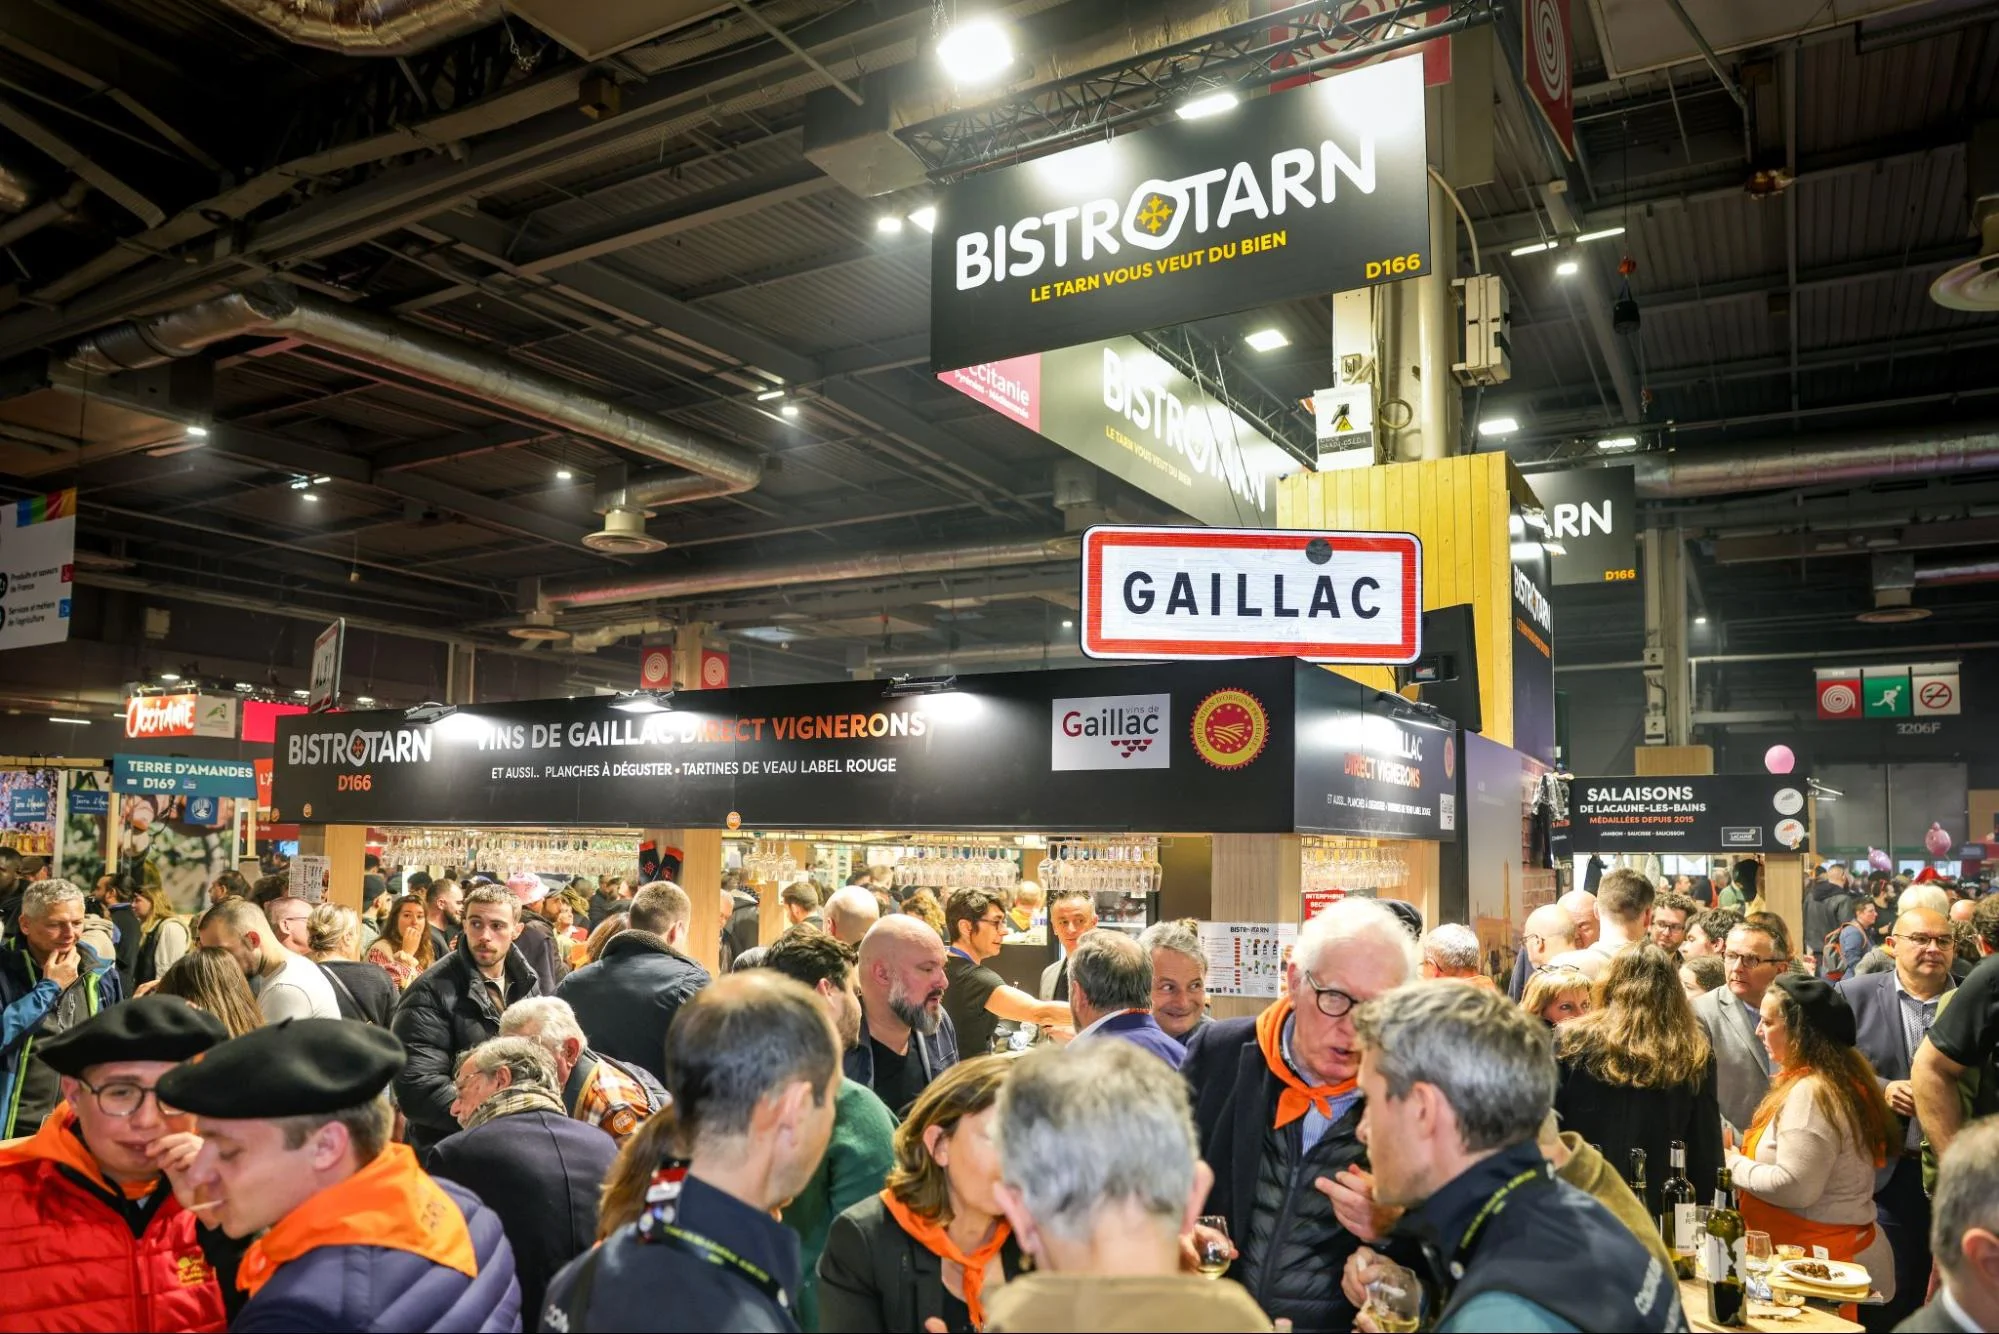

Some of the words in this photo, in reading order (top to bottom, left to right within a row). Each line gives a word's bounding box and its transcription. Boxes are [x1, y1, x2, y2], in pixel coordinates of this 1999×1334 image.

[956, 135, 1376, 291] BISTROTARN
[1031, 284, 1051, 303] LE
[1054, 274, 1099, 297] TARN
[1103, 262, 1153, 287] VOUS
[1156, 250, 1205, 274] VEUT
[1208, 242, 1236, 263] DU
[1241, 230, 1287, 255] BIEN
[1365, 252, 1422, 279] D166
[967, 364, 1030, 406] ccitanie
[1605, 568, 1636, 581] D166
[1123, 571, 1381, 619] GAILLAC
[1126, 706, 1144, 714] vins
[1148, 705, 1159, 713] de
[476, 724, 525, 750] VINS
[531, 723, 562, 748] DE
[568, 719, 674, 747] GAILLAC
[680, 717, 765, 743] DIRECT
[772, 712, 927, 741] VIGNERONS
[1062, 708, 1159, 737] Gaillac
[1896, 722, 1941, 734] 3206F
[288, 728, 433, 767] BISTROTARN
[128, 760, 172, 773] TERRE
[175, 763, 253, 778] D'AMANDES
[491, 767, 504, 779] ET
[545, 764, 600, 778] PLANCHES
[602, 762, 610, 777] À
[613, 761, 672, 777] DÉGUSTER
[682, 762, 739, 775] TARTINES
[742, 761, 759, 774] DE
[763, 760, 797, 773] VEAU
[801, 759, 842, 773] LABEL
[846, 758, 896, 773] ROUGE
[1344, 752, 1375, 780] DIRECT
[1377, 760, 1421, 789] VIGNERONS
[143, 778, 176, 789] D169
[338, 774, 372, 791] D166
[1587, 786, 1693, 802] SALAISONS
[1580, 805, 1594, 813] DE
[1596, 803, 1706, 813] LACAUNE-LES-BAINS
[1589, 815, 1640, 824] MÉDAILLÉES
